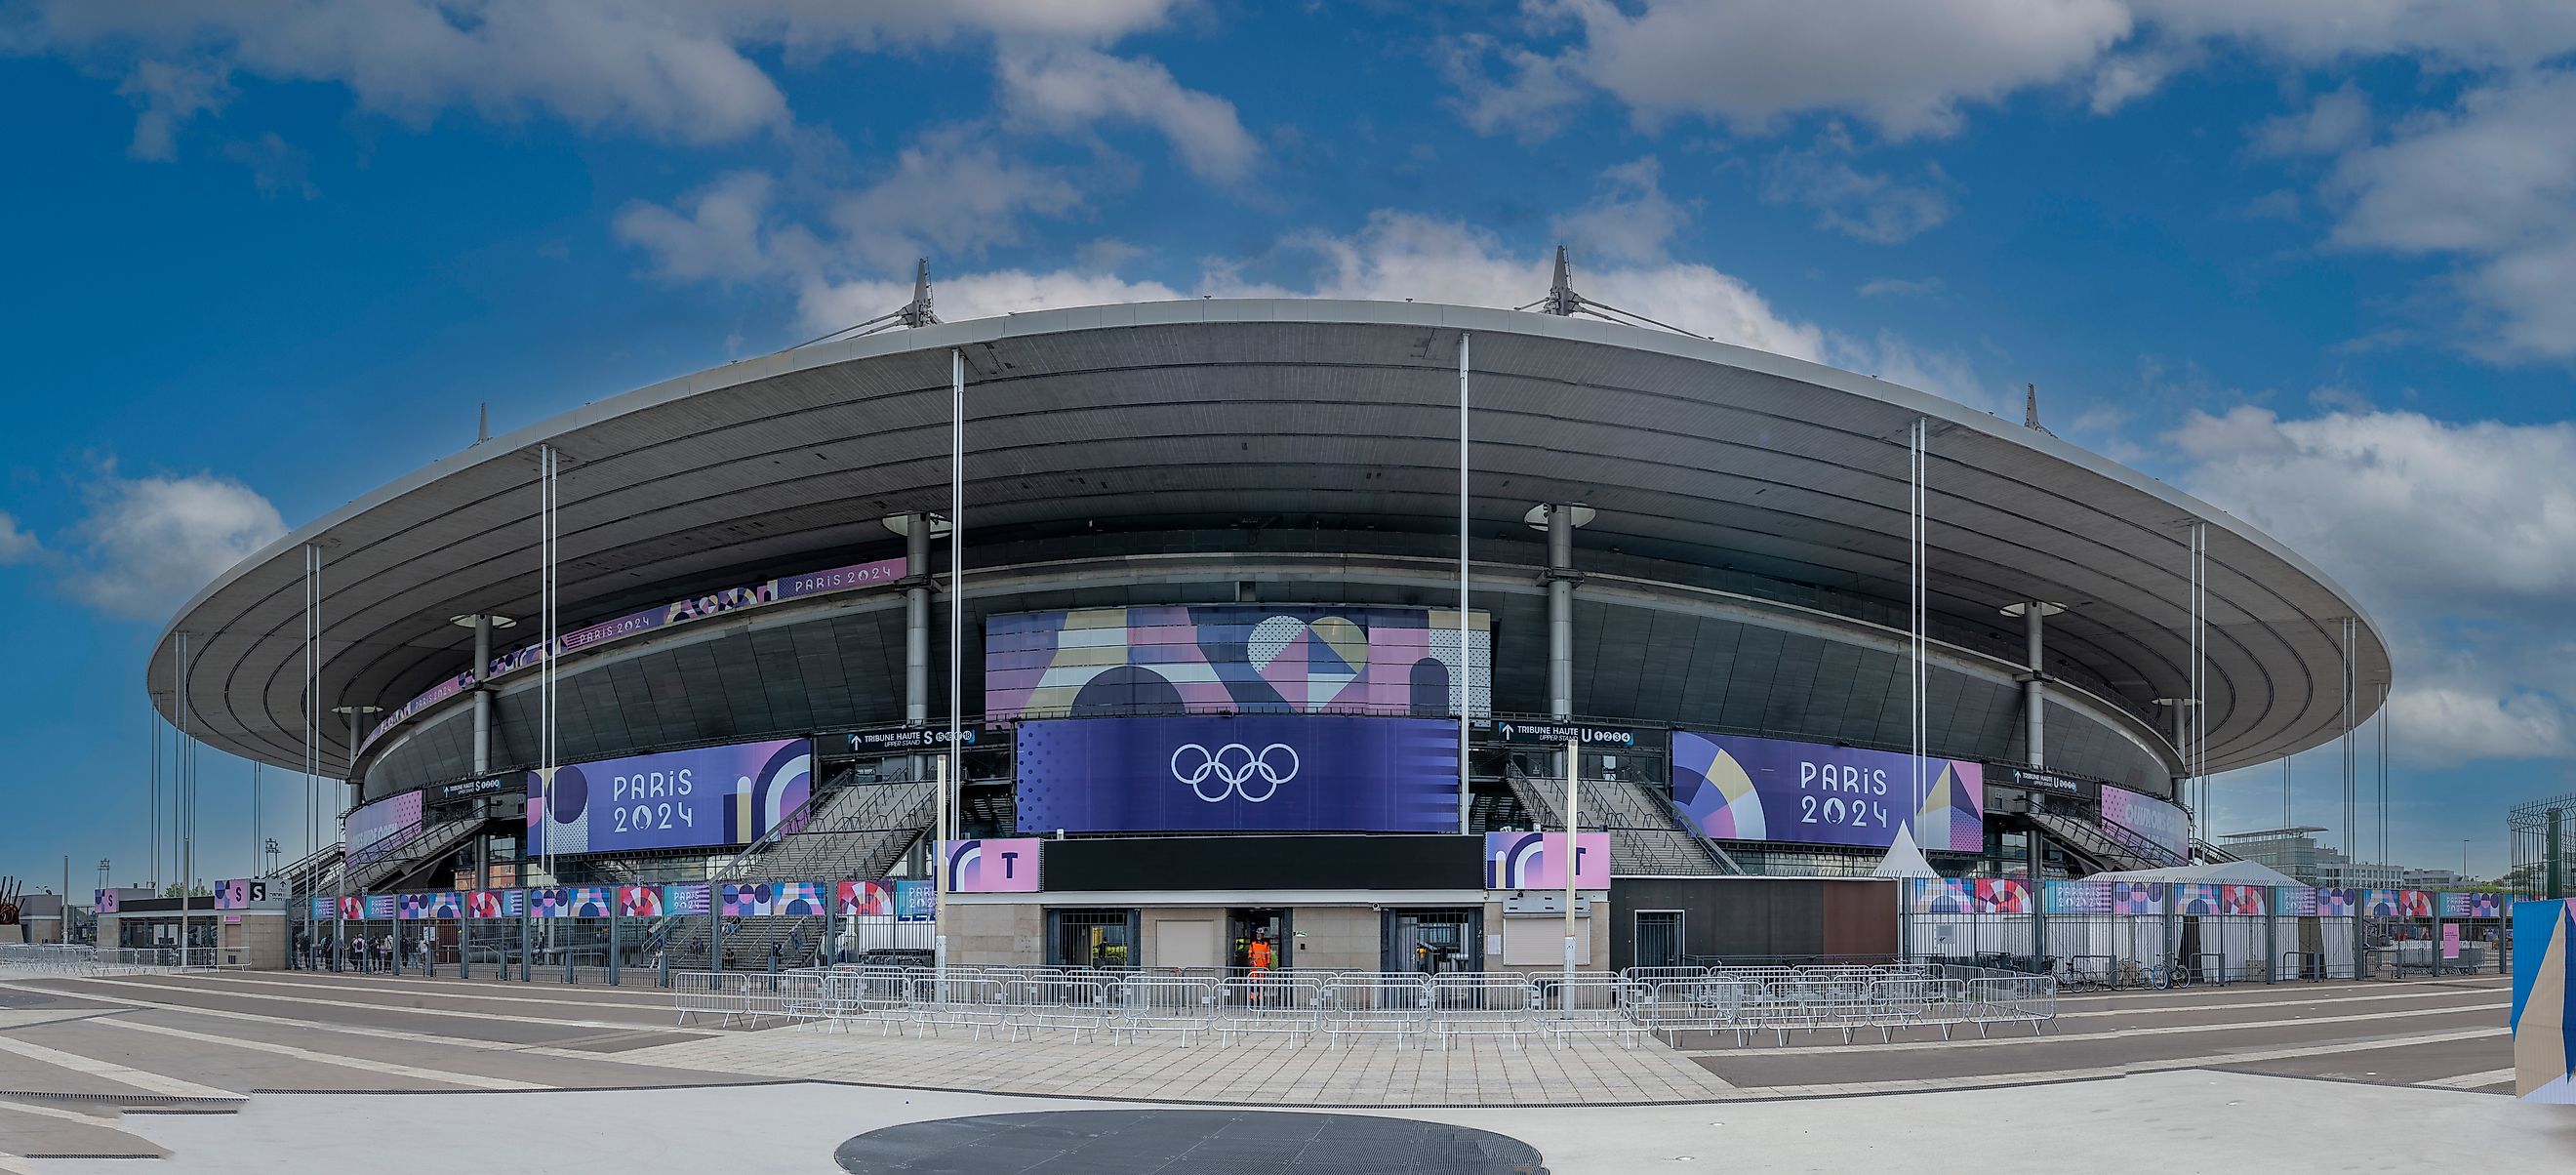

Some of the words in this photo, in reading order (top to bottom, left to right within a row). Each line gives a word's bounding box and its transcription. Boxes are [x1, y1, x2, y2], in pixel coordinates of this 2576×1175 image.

[847, 566, 891, 584] 2024
[617, 617, 650, 633] 2024
[865, 733, 895, 743] TRIBUNE
[896, 731, 921, 741] HAUTE
[923, 730, 933, 745] S
[1517, 725, 1550, 735] TRIBUNE
[1552, 726, 1579, 736] HAUTE
[1581, 728, 1591, 743] U
[475, 781, 481, 791] S
[2053, 777, 2059, 788] U
[614, 802, 693, 833] 2024
[1801, 795, 1887, 829] 2024
[2125, 803, 2166, 831] OUVRONS
[1001, 852, 1019, 879] T
[108, 895, 113, 907] S
[236, 887, 242, 902] S
[253, 886, 263, 901] S
[674, 901, 700, 909] 2024
